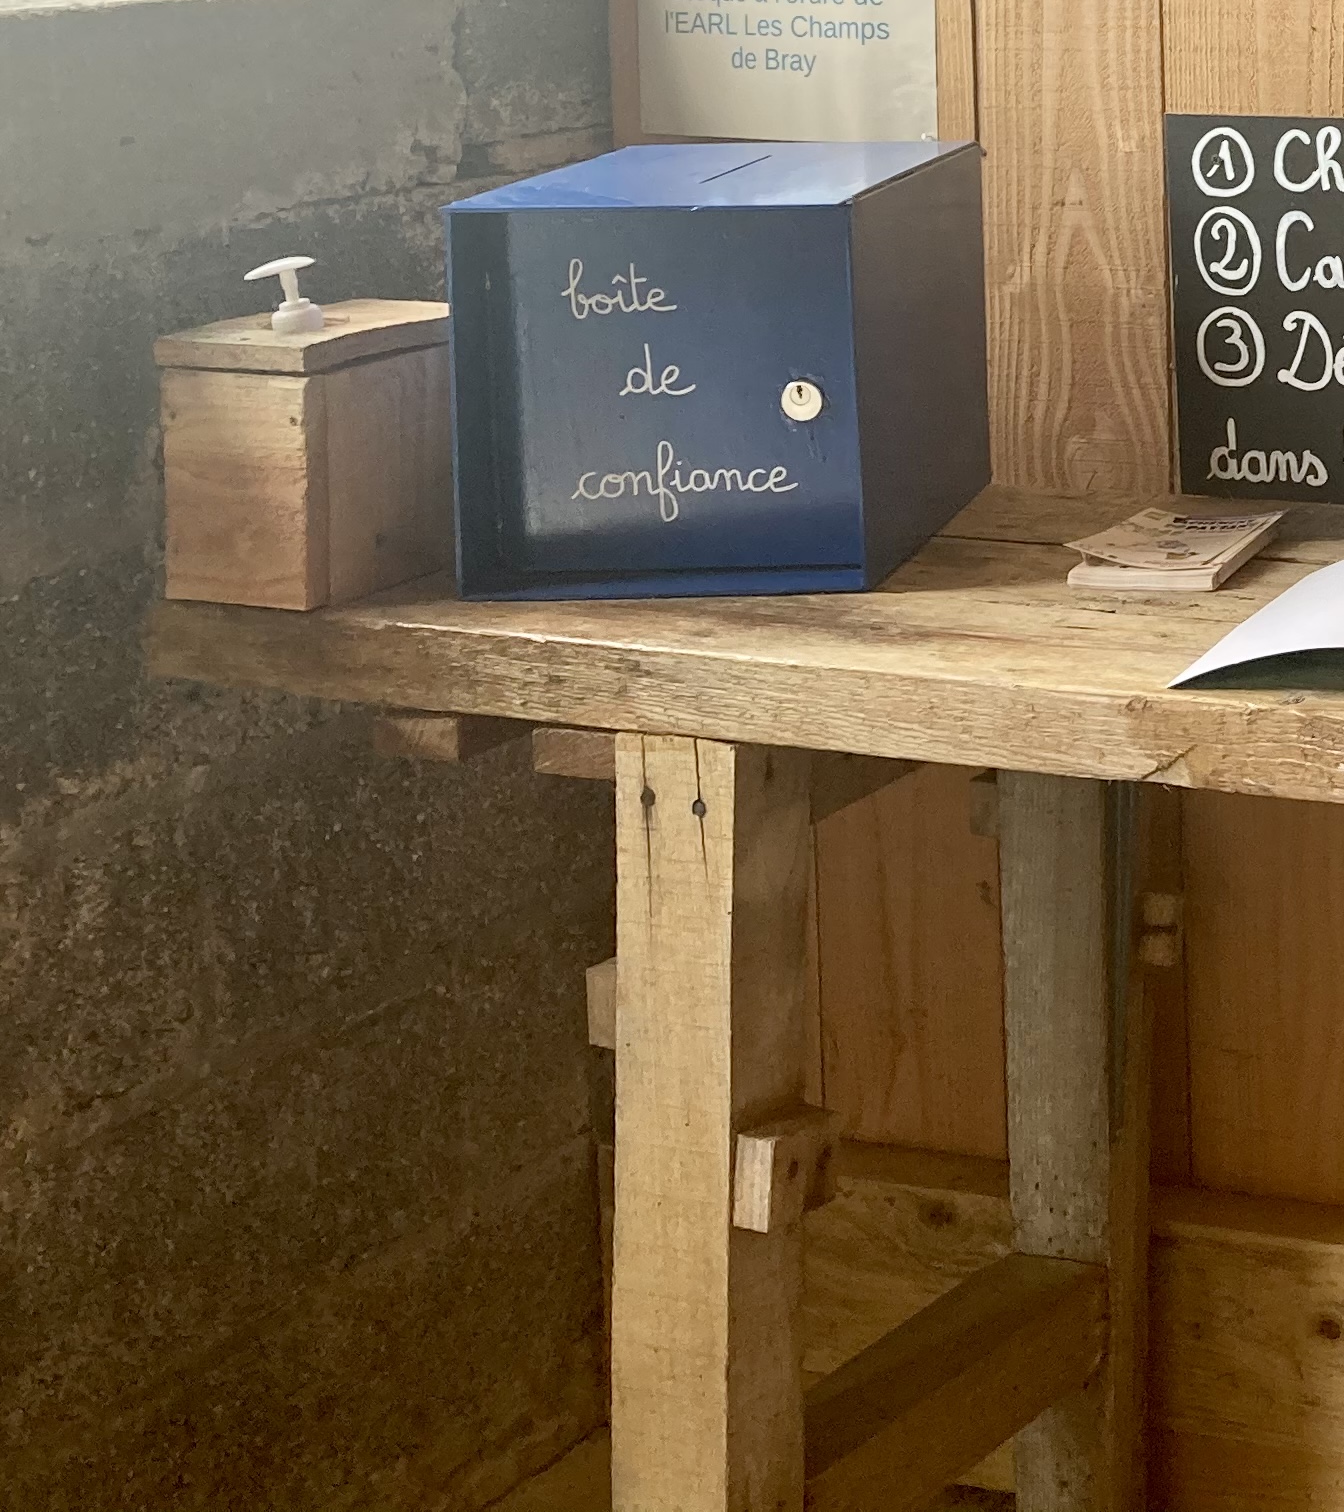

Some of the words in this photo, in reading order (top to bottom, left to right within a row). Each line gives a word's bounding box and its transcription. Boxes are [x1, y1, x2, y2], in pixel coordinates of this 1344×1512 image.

[664, 10, 736, 35] l'EARL
[745, 14, 782, 37] Les
[791, 16, 890, 45] Champs
[732, 46, 756, 69] de
[765, 48, 816, 77] Bray
[561, 258, 677, 319] boîte
[620, 343, 696, 396] de
[1206, 418, 1328, 484] dans
[571, 440, 798, 522] confiance
